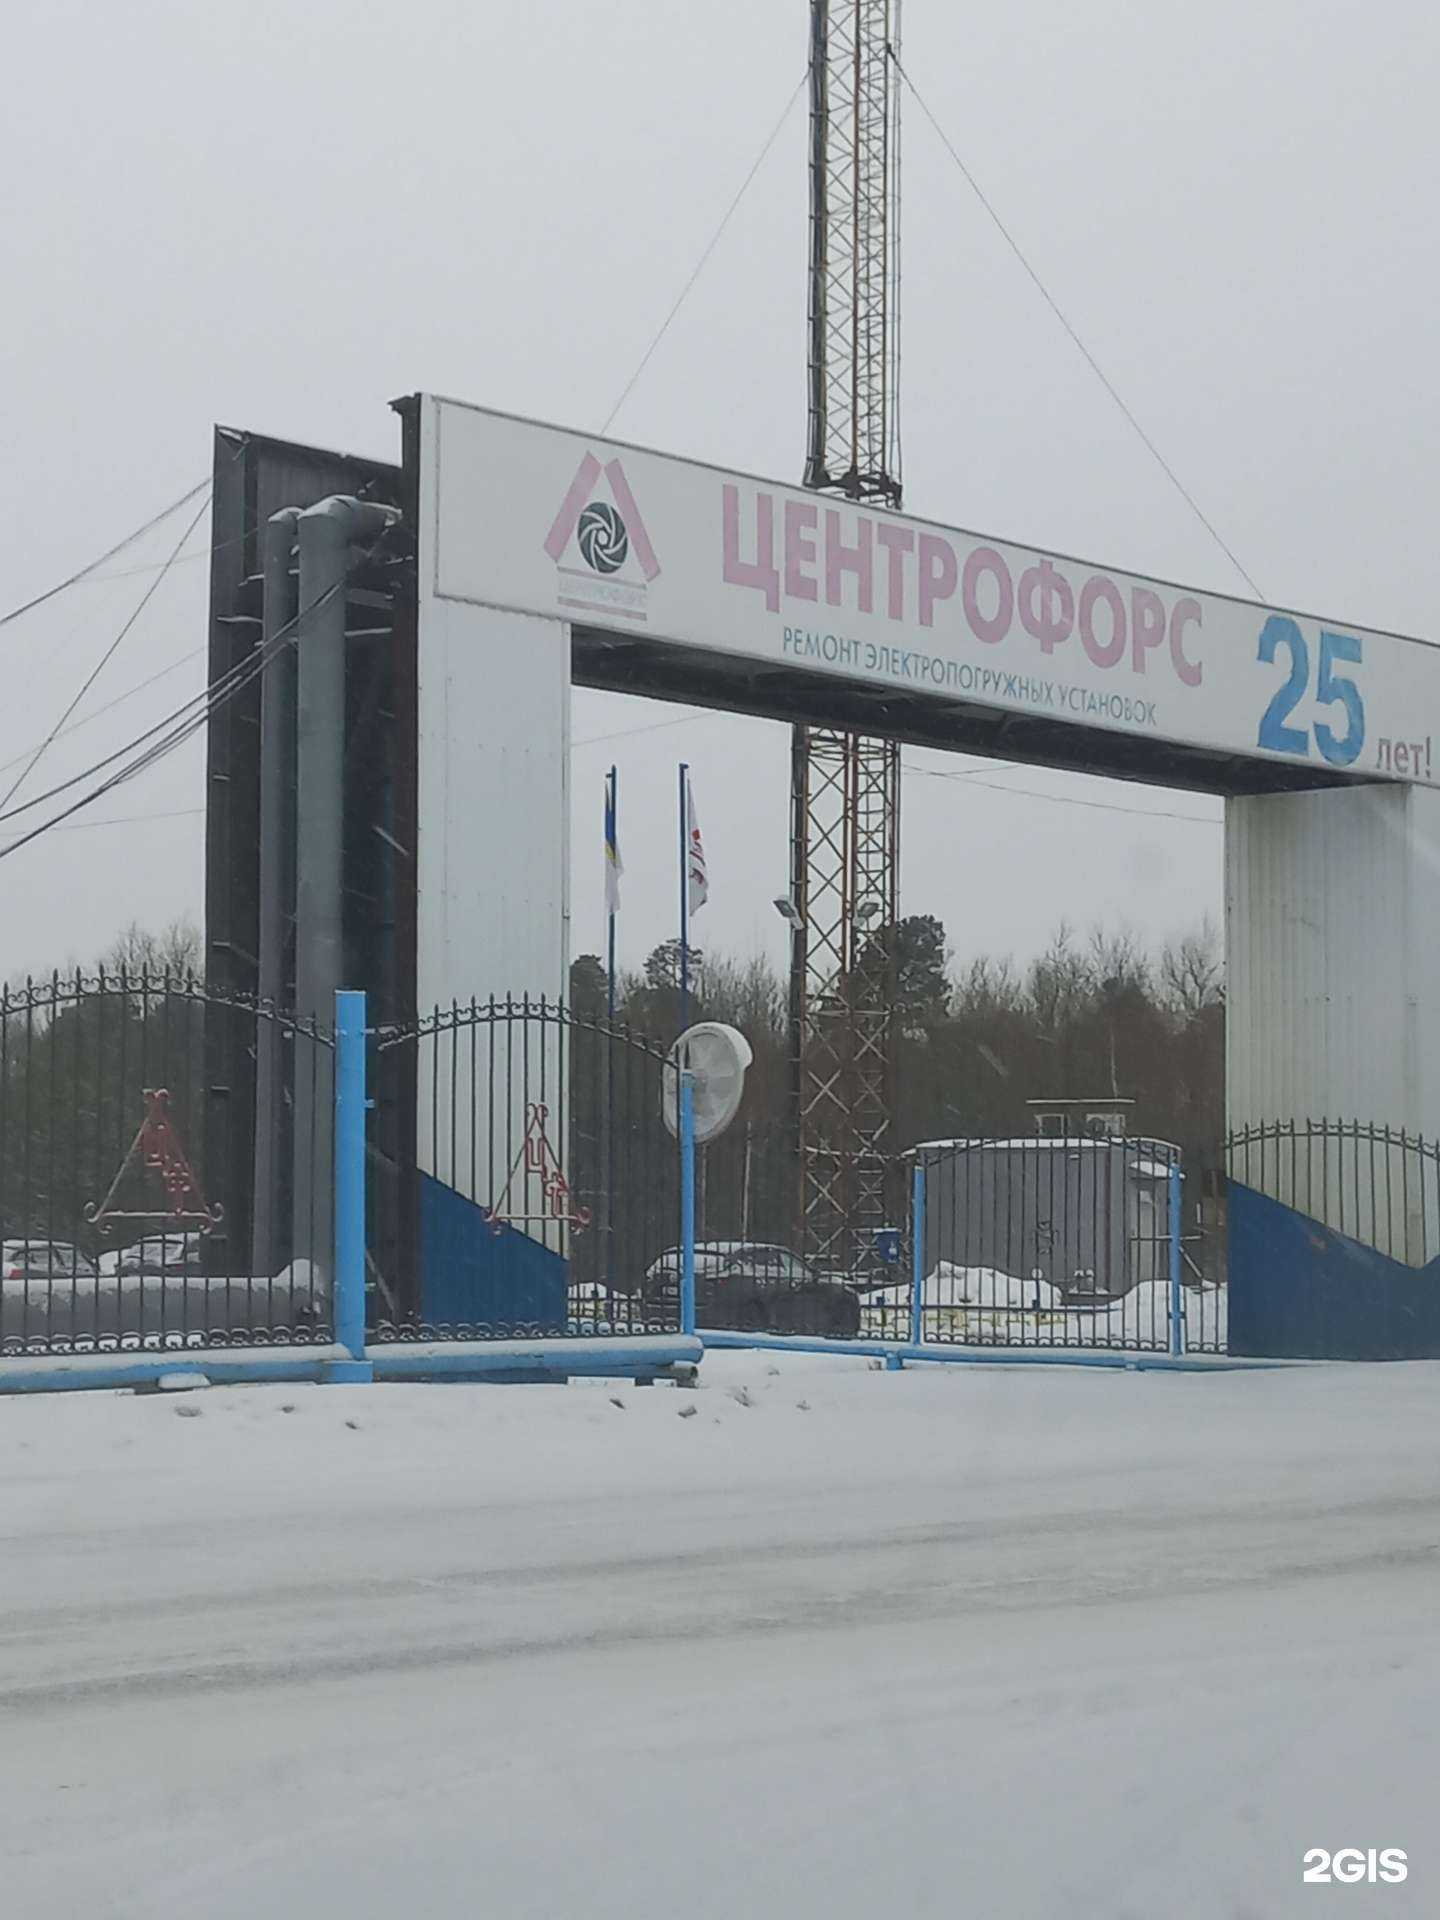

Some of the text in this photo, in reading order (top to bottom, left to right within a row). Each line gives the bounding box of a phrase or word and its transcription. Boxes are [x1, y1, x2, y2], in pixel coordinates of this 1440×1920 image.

[723, 484, 1202, 687] ЦЕНТРОФОРС
[783, 626, 1156, 726] РЕМОНТ ЭЛЕКТРОПОГРУЖНЫХ УСТАНОВОК
[1256, 615, 1431, 778] 25 лет!
